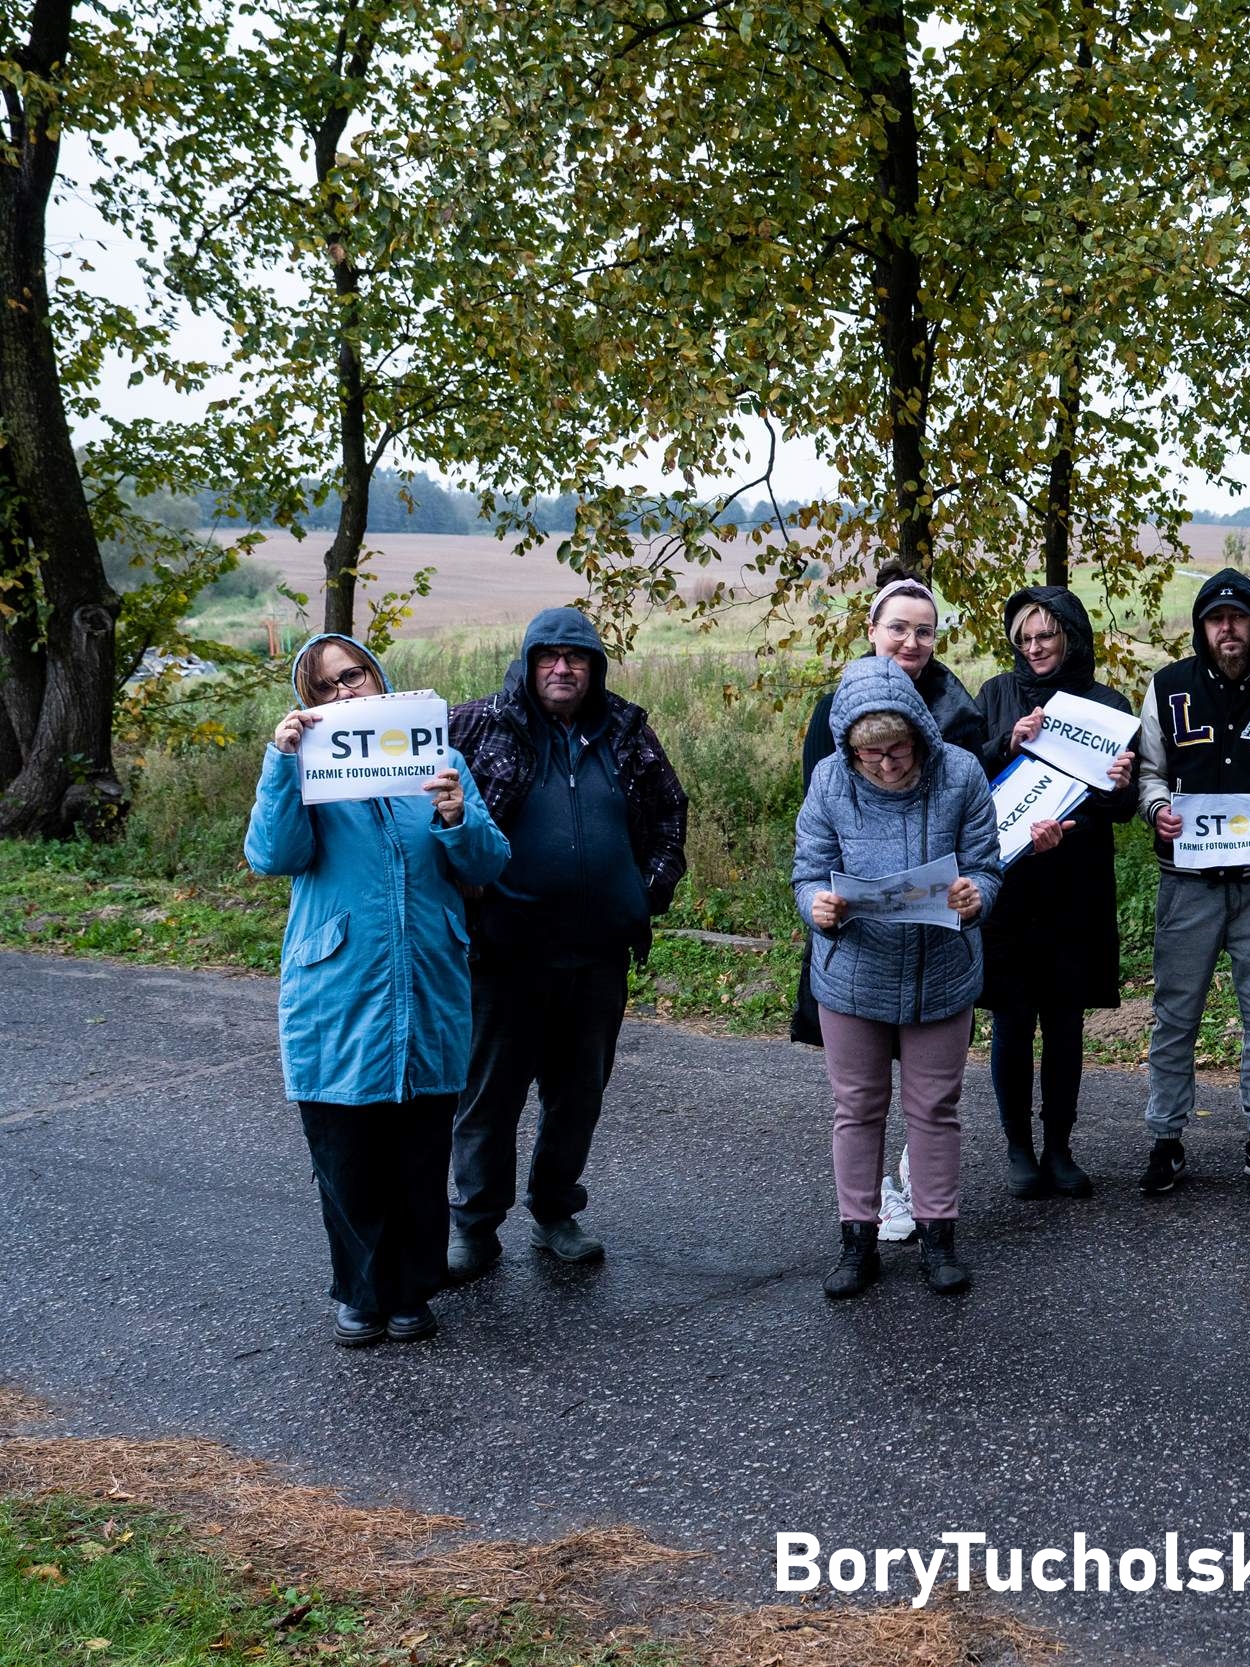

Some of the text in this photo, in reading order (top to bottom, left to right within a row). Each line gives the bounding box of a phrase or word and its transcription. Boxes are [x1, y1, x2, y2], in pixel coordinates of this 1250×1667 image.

[1041, 716, 1121, 757] SPRZECIW
[1169, 693, 1214, 747] L
[331, 727, 444, 760] STOP!
[306, 765, 435, 780] FARMIE FOTOWOLTAICZNEJ
[1180, 842, 1204, 852] FARMIE
